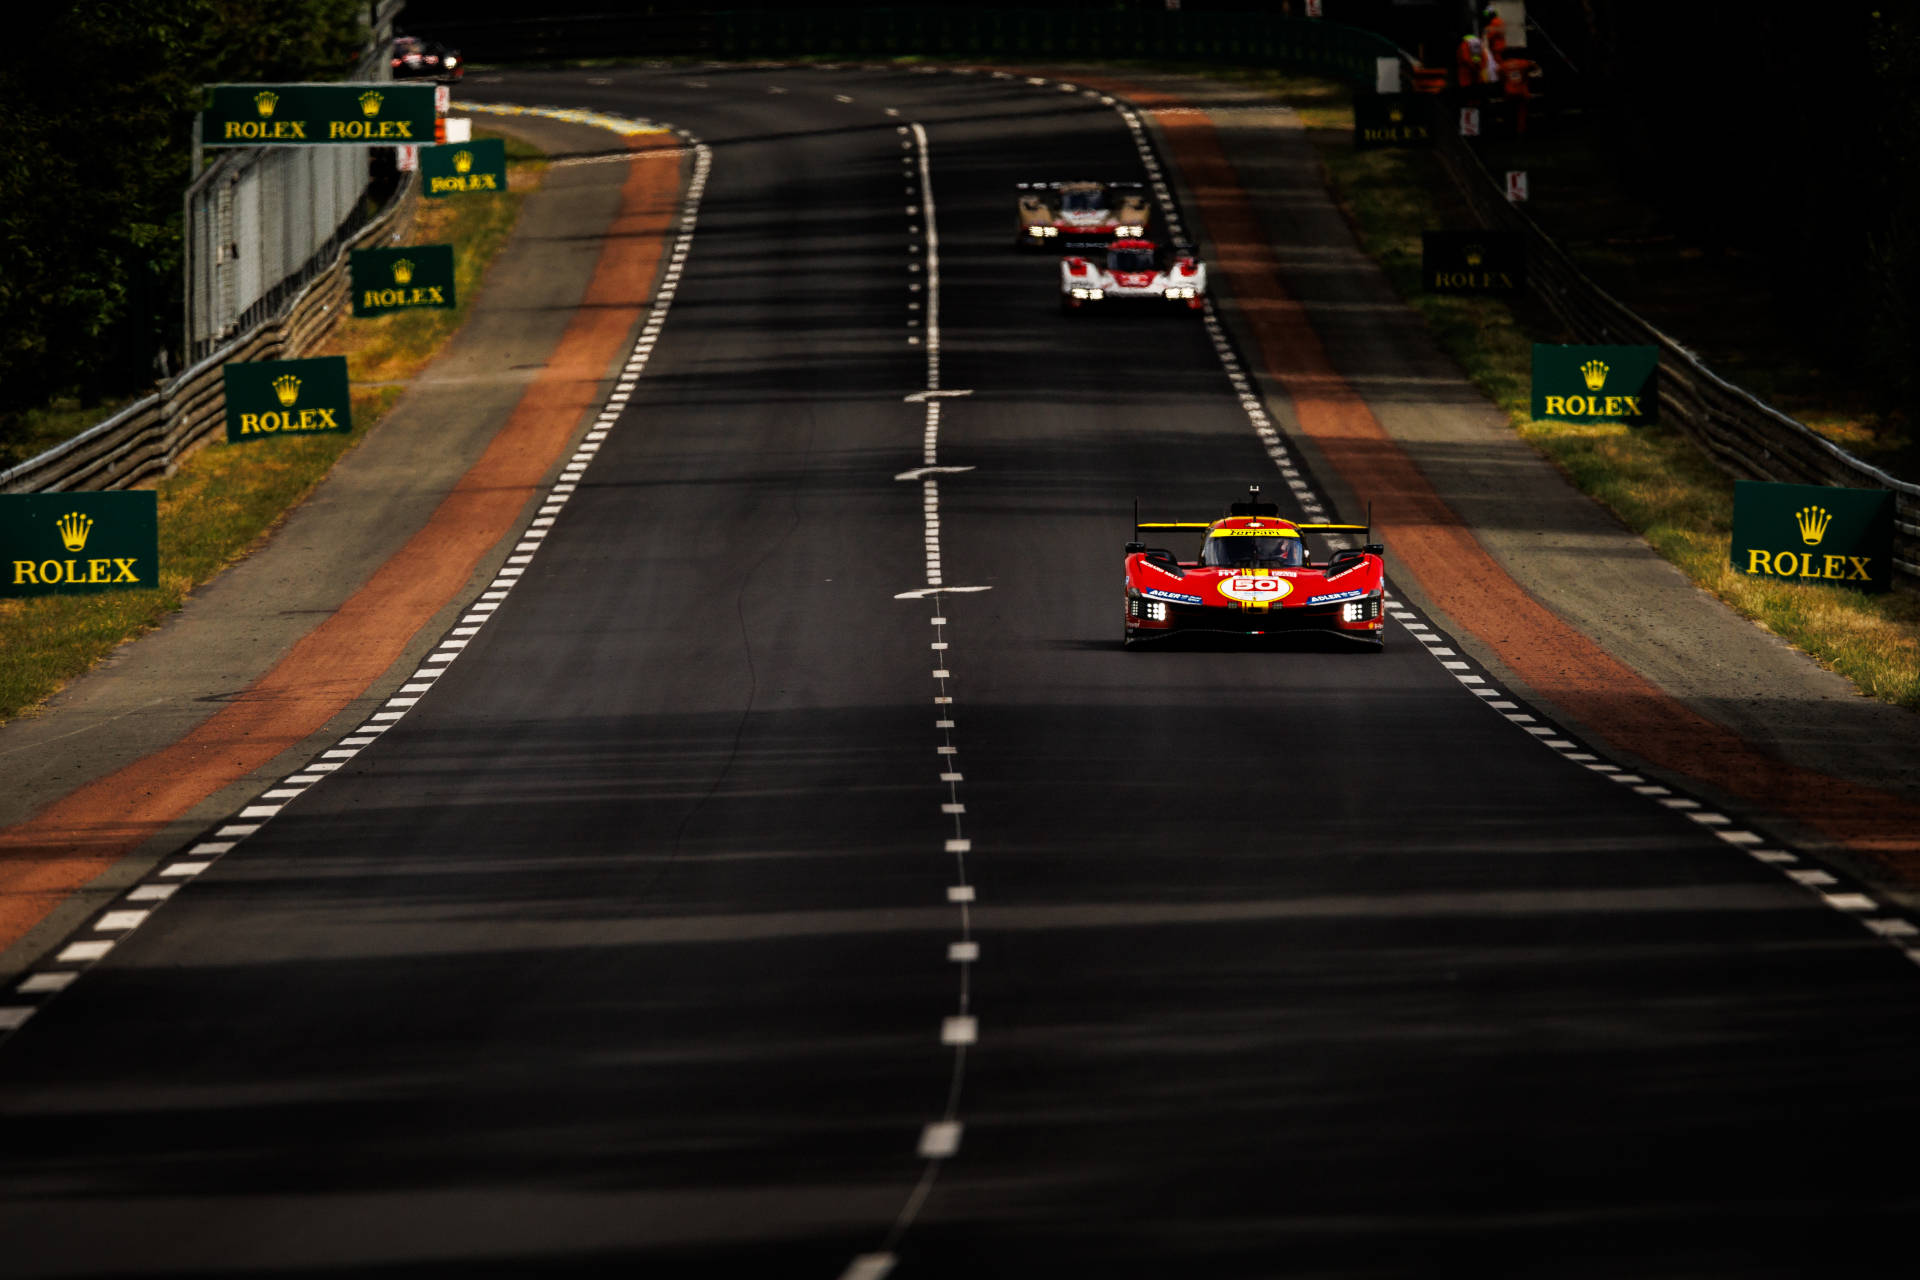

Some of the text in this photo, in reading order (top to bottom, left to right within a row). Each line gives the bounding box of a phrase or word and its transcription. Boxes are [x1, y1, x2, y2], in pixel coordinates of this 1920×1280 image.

[225, 121, 413, 138] ROLEX ROLEX
[431, 173, 497, 193] ROLEX
[1435, 272, 1513, 288] ROLEX
[363, 286, 444, 308] ROLEX
[1545, 395, 1642, 416] ROLEX
[240, 408, 338, 434] ROLEX
[12, 558, 140, 584] ROLEX
[1746, 549, 1873, 581] ROLEX
[1149, 589, 1181, 599] ADLER
[1235, 580, 1276, 590] 50
[1311, 593, 1341, 602] ADLER
